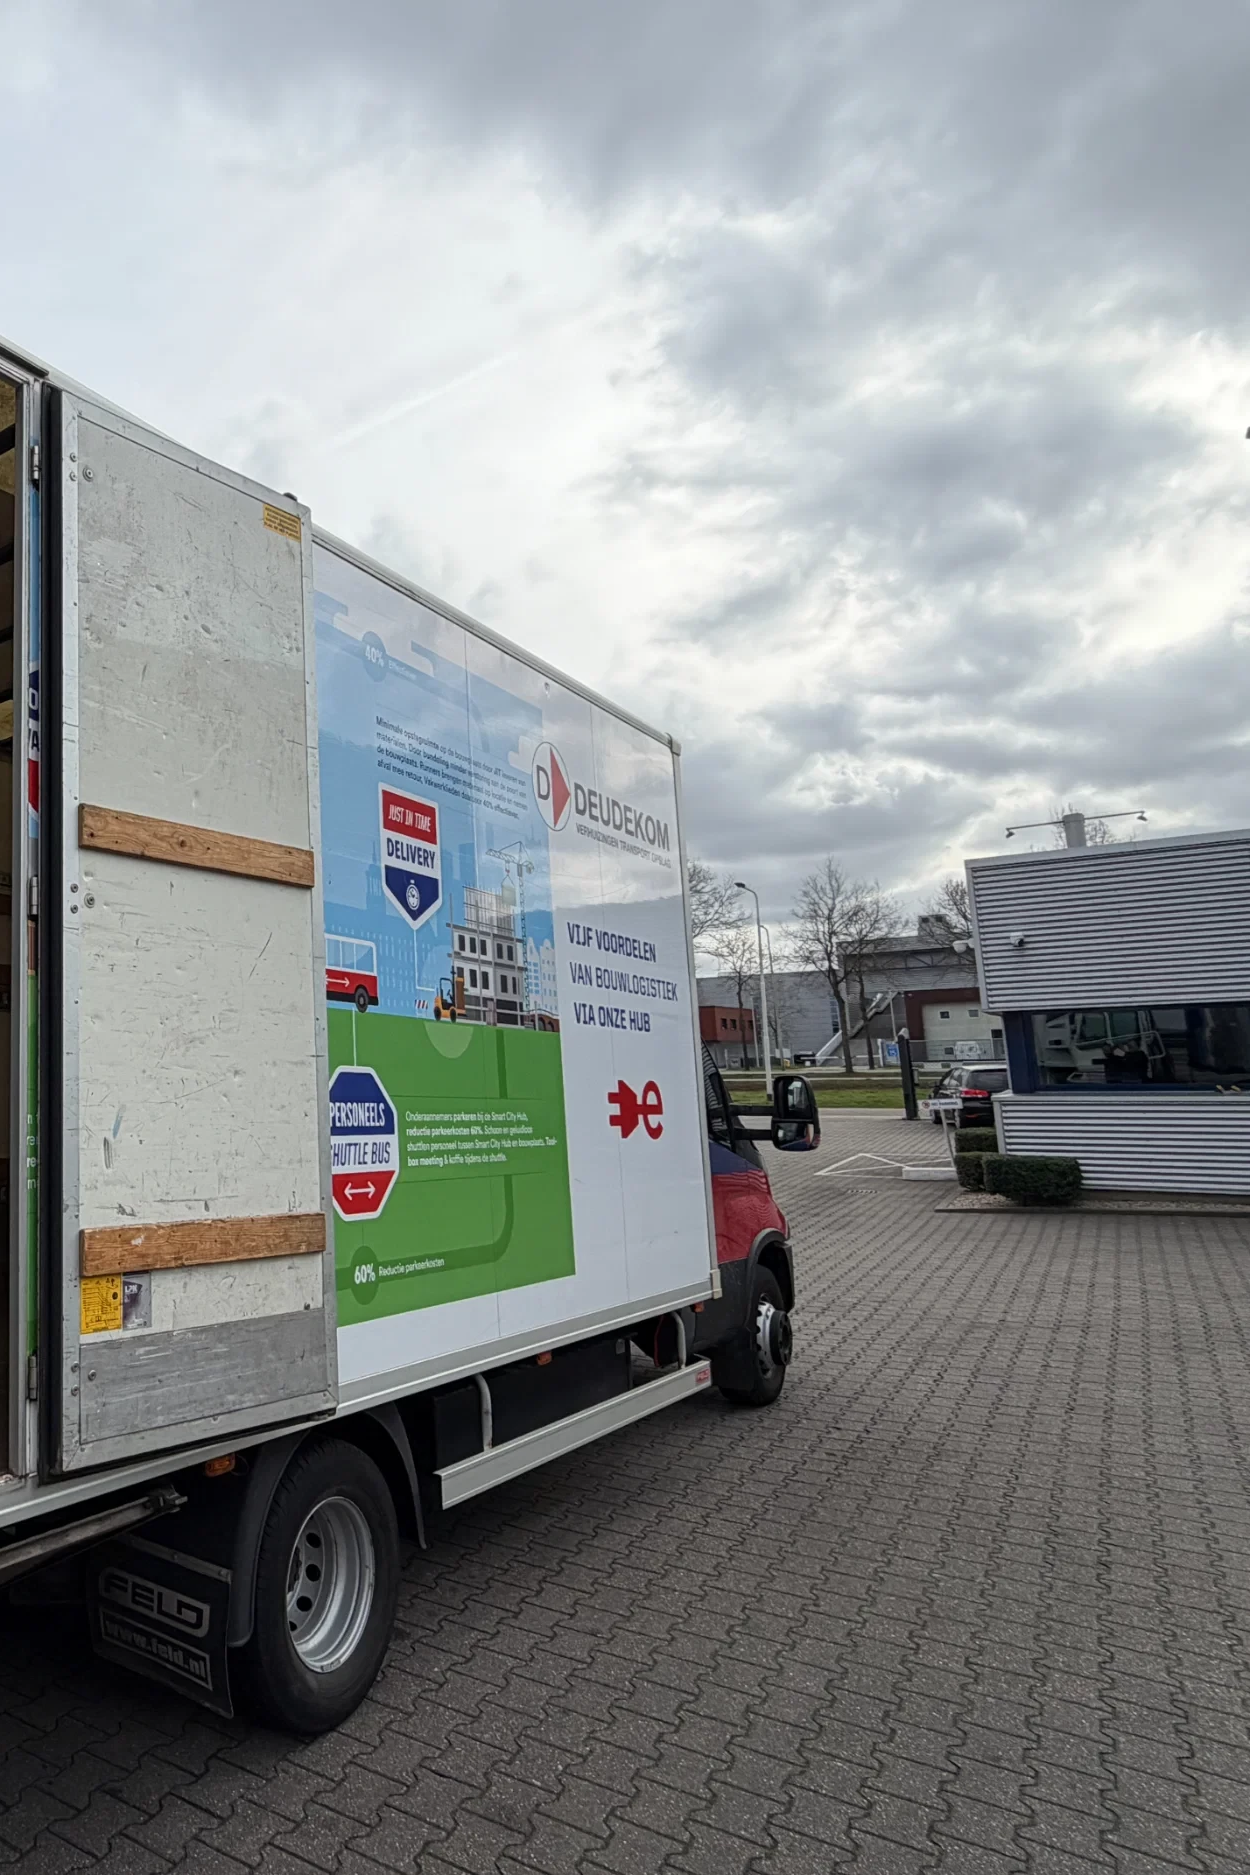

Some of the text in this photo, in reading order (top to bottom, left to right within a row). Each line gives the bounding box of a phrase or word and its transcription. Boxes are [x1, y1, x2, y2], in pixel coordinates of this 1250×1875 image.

[365, 644, 384, 668] 40%
[536, 764, 551, 801] D
[388, 804, 432, 832] JUST IN TIME
[574, 782, 671, 851] DEUDEKOM
[387, 837, 436, 869] DELIVERY
[576, 822, 672, 869] VERHUIZINGEN TRANSPORT OPSLAG
[567, 922, 657, 963] VIJF VOORDELEN
[570, 962, 678, 1002] VAN BOUWLOGISTIEK
[574, 1002, 651, 1033] VIA ONZE HUB
[329, 1101, 386, 1127] PERSONEELS
[453, 1111, 477, 1123] parkeren
[491, 1111, 506, 1121] Smart
[506, 1111, 516, 1122] City
[406, 1125, 430, 1136] reductie
[431, 1125, 470, 1138] parkeerkosten
[430, 1140, 457, 1152] personeel
[475, 1138, 490, 1149] Smart
[490, 1138, 501, 1150] City
[501, 1138, 511, 1148] Hub
[330, 1141, 391, 1167] HUTTLE BUS
[419, 1155, 444, 1167] meeting
[354, 1259, 445, 1285] 60% Reductie parkeerkosten
[103, 1571, 205, 1631] FELD
[105, 1620, 207, 1679] www.feld.nl
